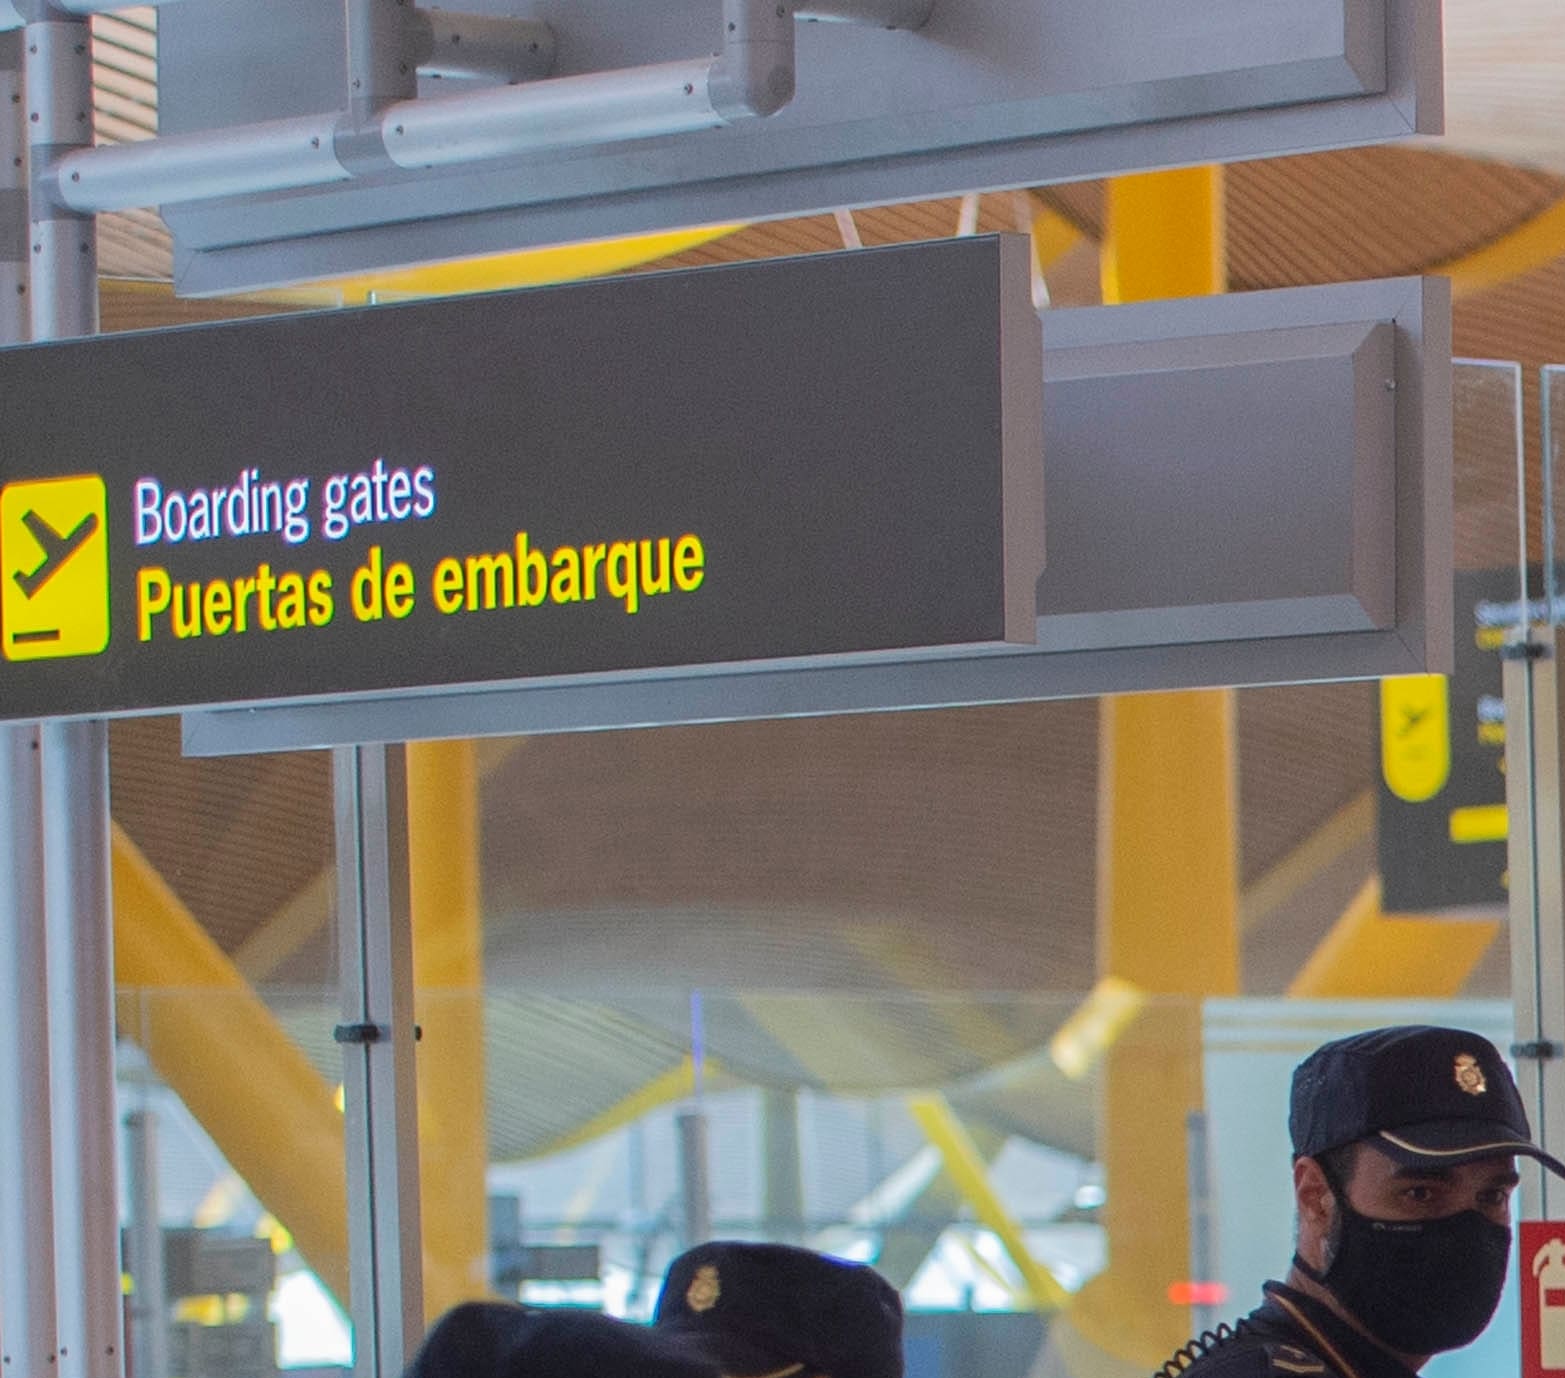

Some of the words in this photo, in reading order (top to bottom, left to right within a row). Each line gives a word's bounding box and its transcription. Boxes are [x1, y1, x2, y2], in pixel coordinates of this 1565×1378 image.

[134, 467, 310, 545] Boarding
[323, 457, 435, 541] gates
[136, 564, 334, 642] Puertas
[351, 548, 415, 622] de
[433, 533, 705, 615] embarque
